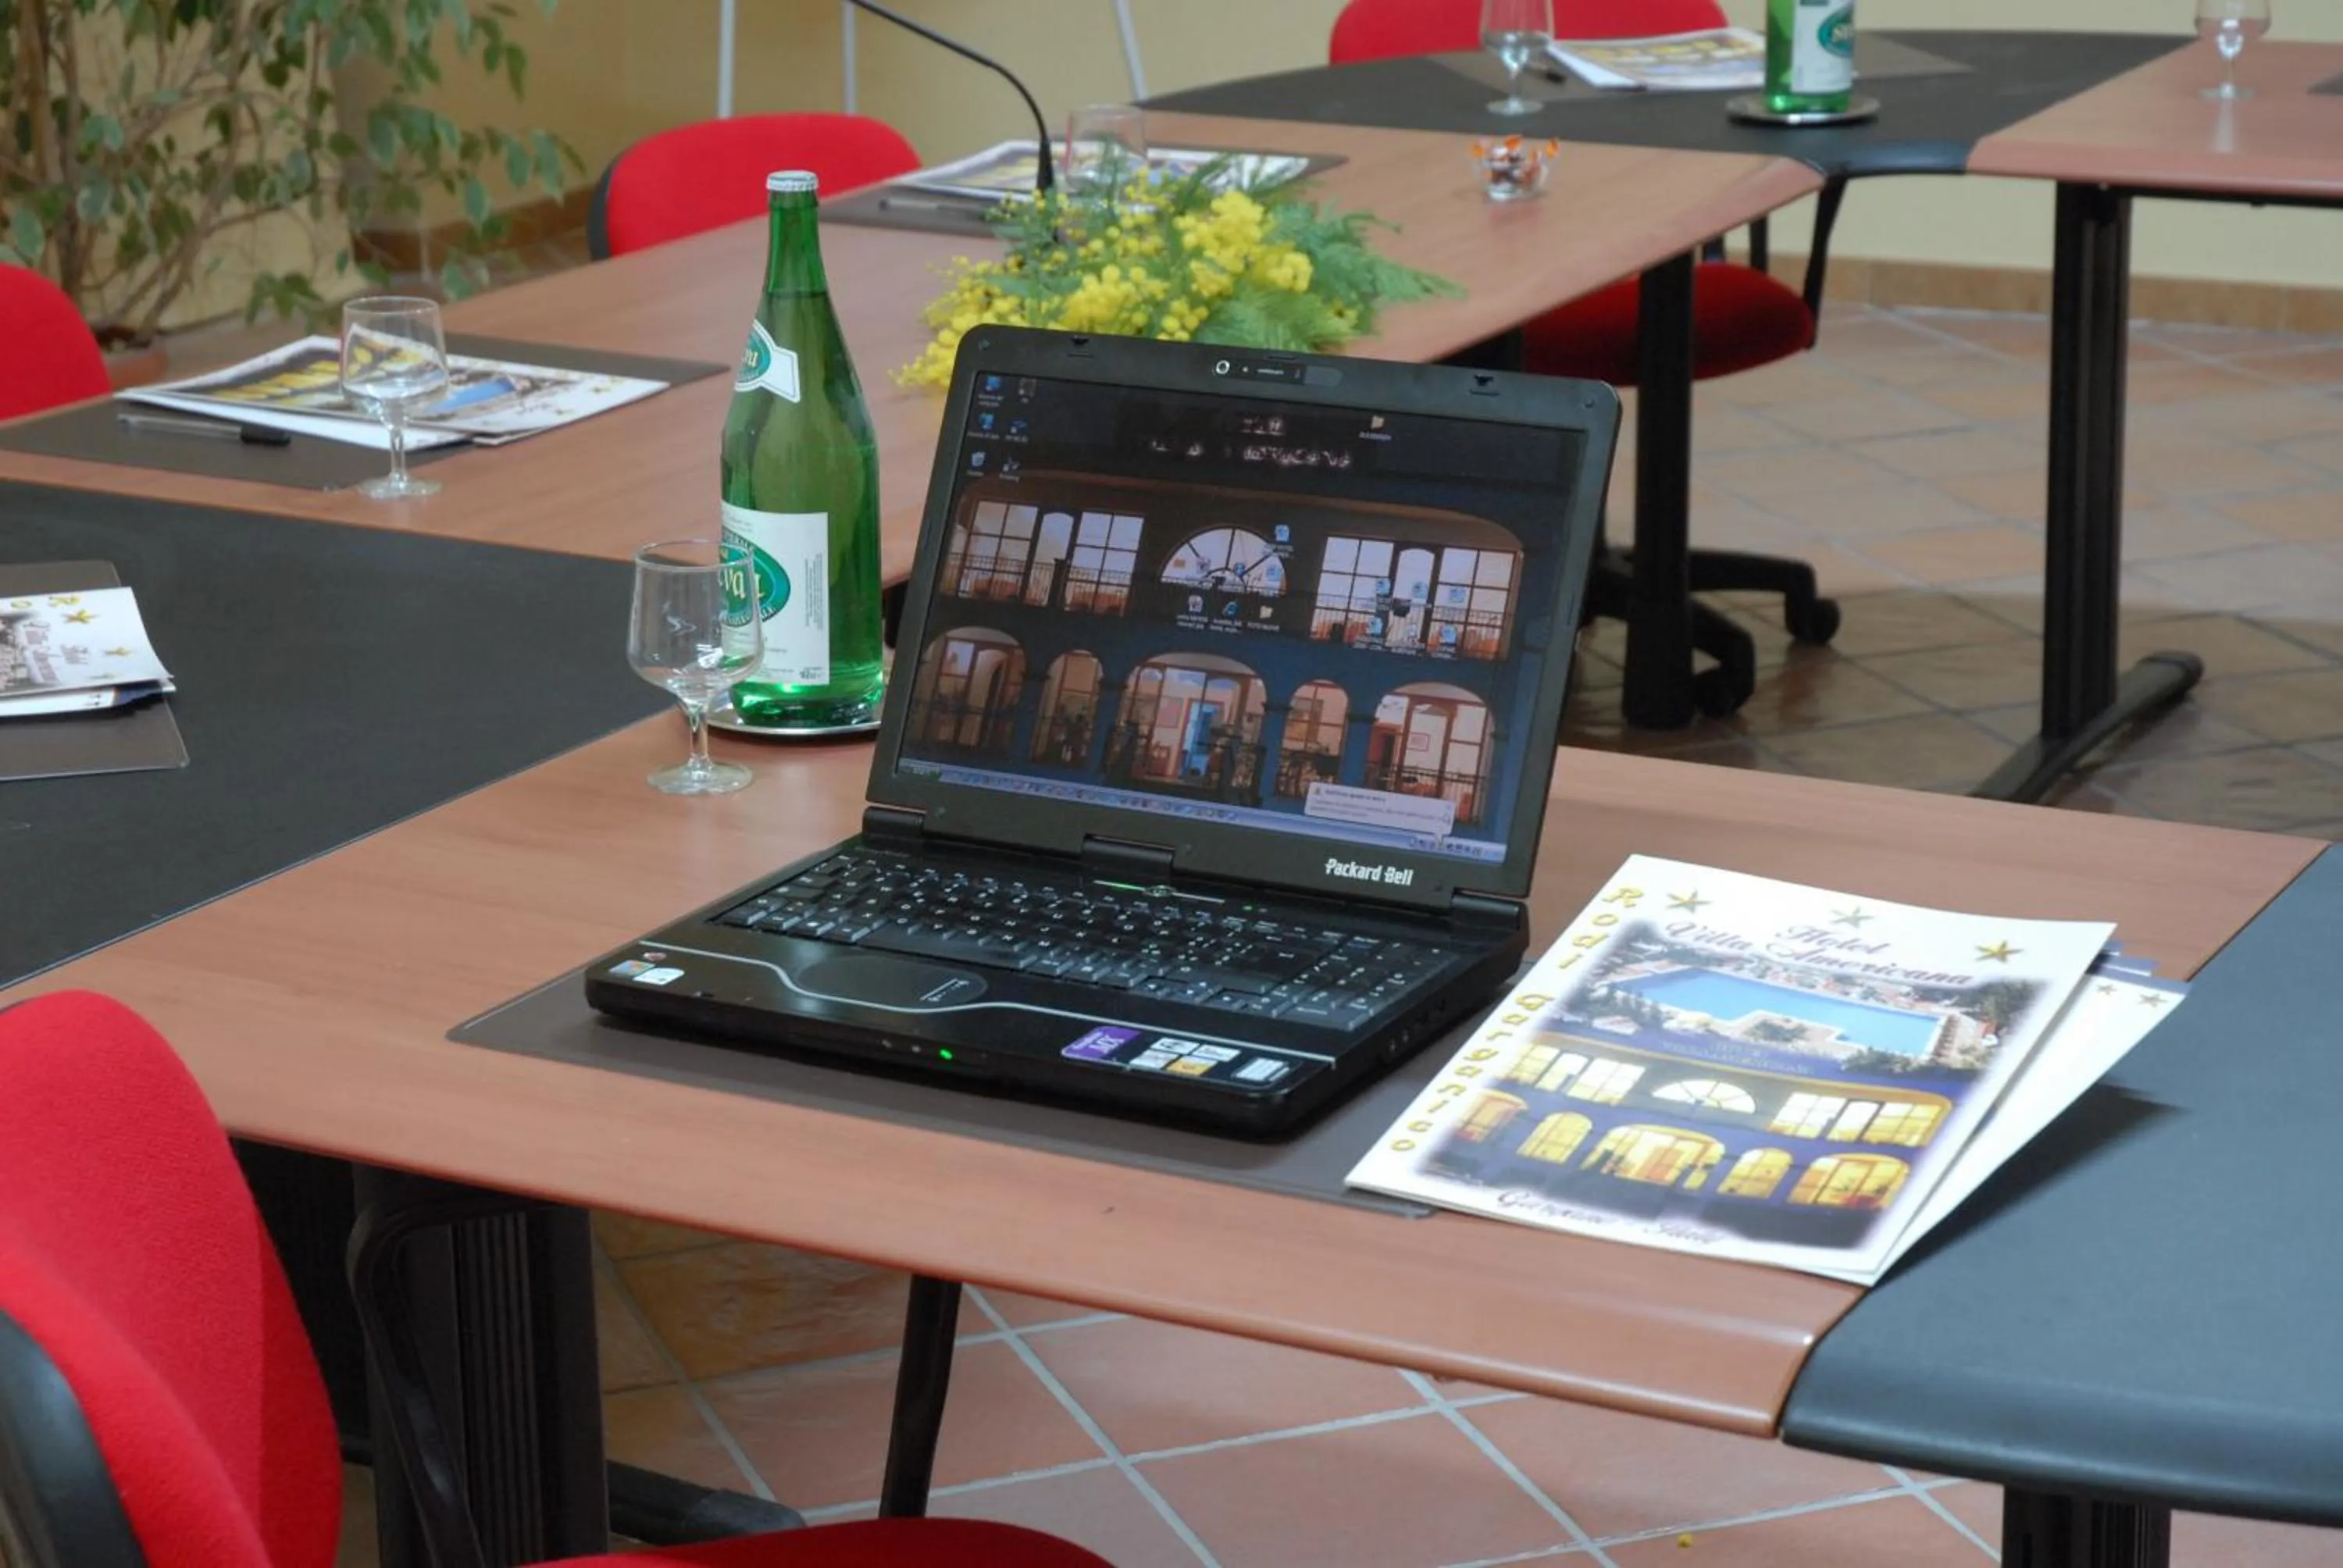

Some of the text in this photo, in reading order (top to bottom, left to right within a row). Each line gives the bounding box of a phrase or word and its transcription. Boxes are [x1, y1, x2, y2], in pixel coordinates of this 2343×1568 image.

[1325, 857, 1414, 886] Packard Bell
[1664, 921, 1754, 950] Villa
[1775, 925, 1892, 956] Hotel
